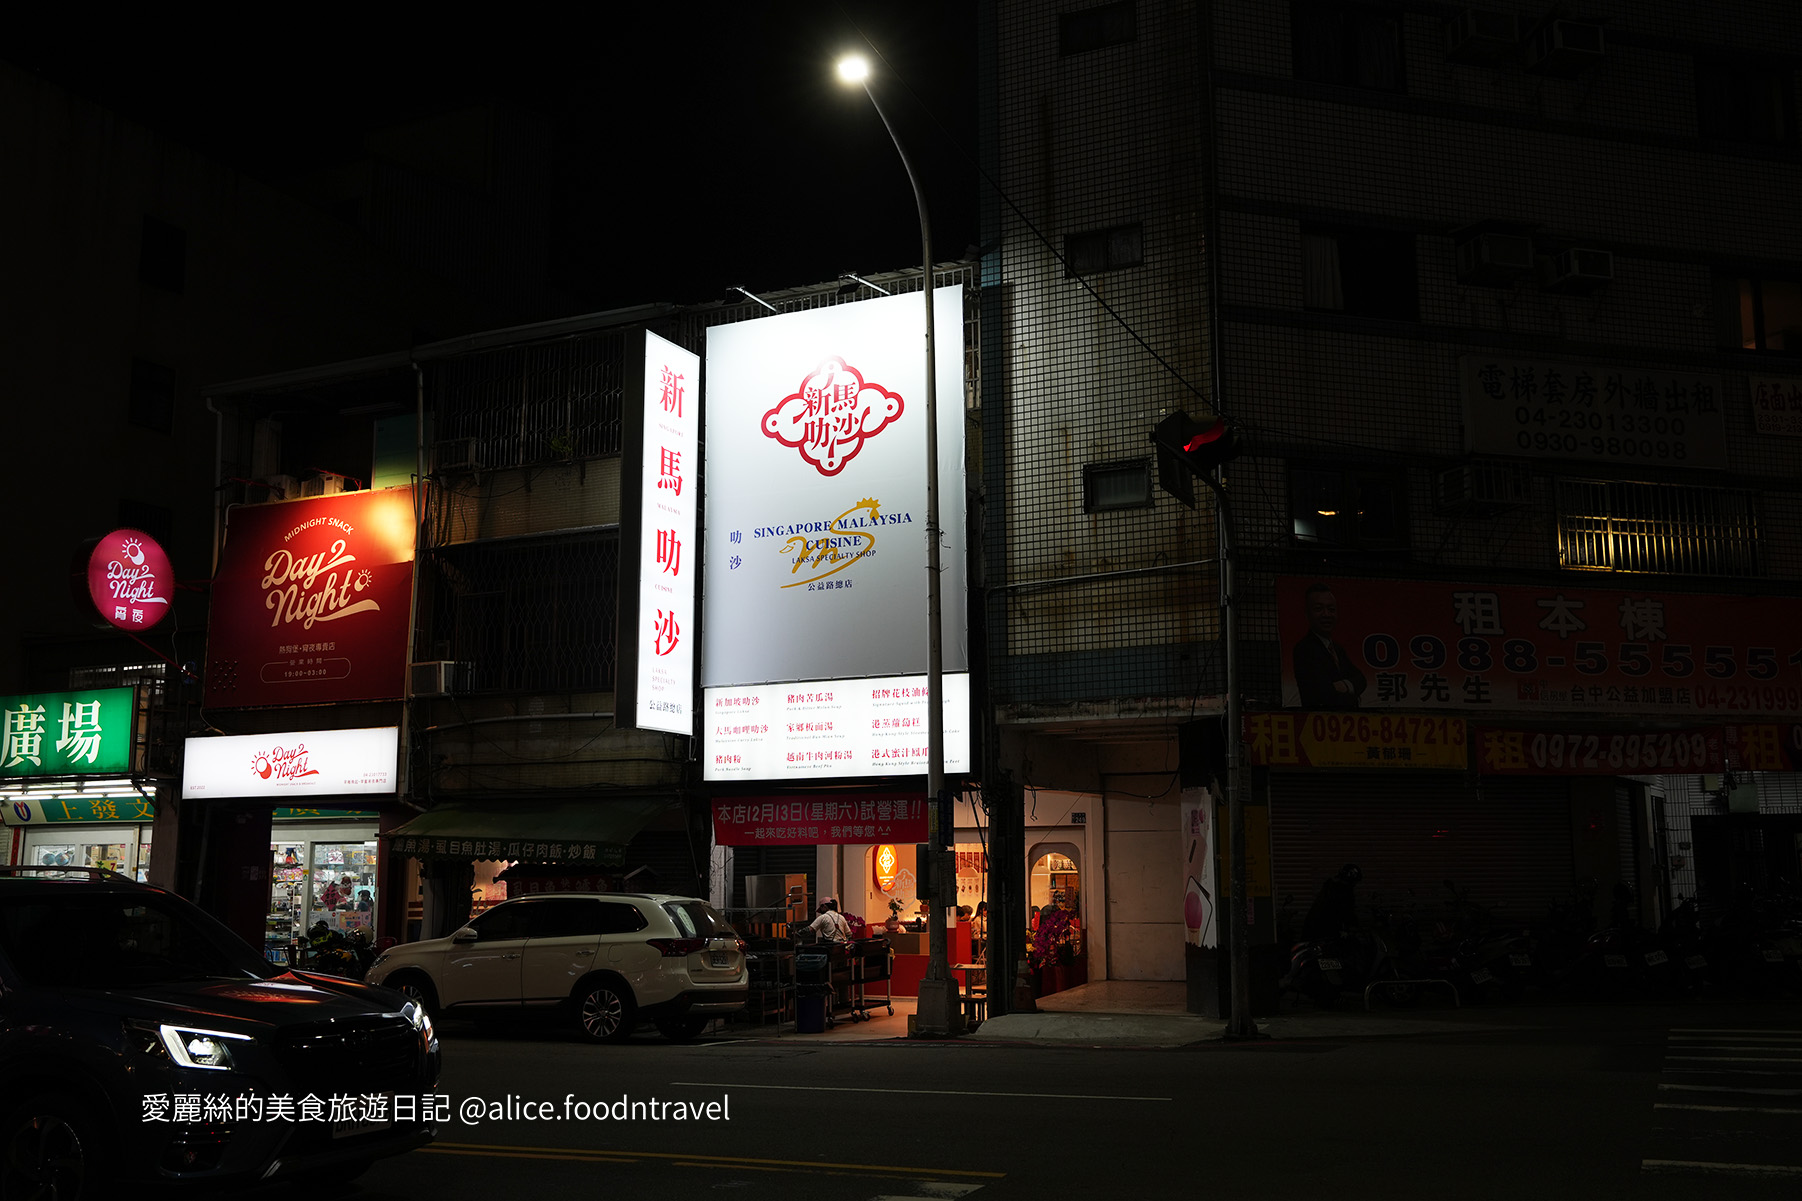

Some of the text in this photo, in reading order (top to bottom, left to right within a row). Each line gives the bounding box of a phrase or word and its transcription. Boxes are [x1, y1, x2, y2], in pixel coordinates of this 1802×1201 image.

[1478, 364, 1719, 416] 電梯套房外牆出租
[1515, 405, 1685, 436] 04-23013300
[1516, 430, 1687, 461] 0930-980098
[283, 517, 354, 543] MIDNIGHT SNACK
[753, 512, 913, 539] SINGAPORE MALAYSIA
[805, 535, 862, 551] CUISINE
[791, 549, 877, 565] LAKSA SPECIALTY SHOP
[109, 578, 168, 604] Night
[807, 579, 853, 592] 公益路總店
[265, 569, 380, 630] Night
[115, 605, 144, 624] 宵夜
[715, 696, 760, 707] 新加坡叻沙
[1376, 673, 1492, 704] 郭先生
[1570, 684, 1691, 705] 台中公益加盟店
[1695, 684, 1802, 711] 04-231999
[0, 700, 102, 768] 廣場
[1251, 713, 1299, 765] 租
[1312, 715, 1465, 746] 0926-847213
[1484, 731, 1529, 770] 租
[1531, 732, 1707, 769] 0972-895209
[1742, 724, 1784, 771] 租
[274, 757, 320, 781] Night
[57, 798, 154, 820] 上發文
